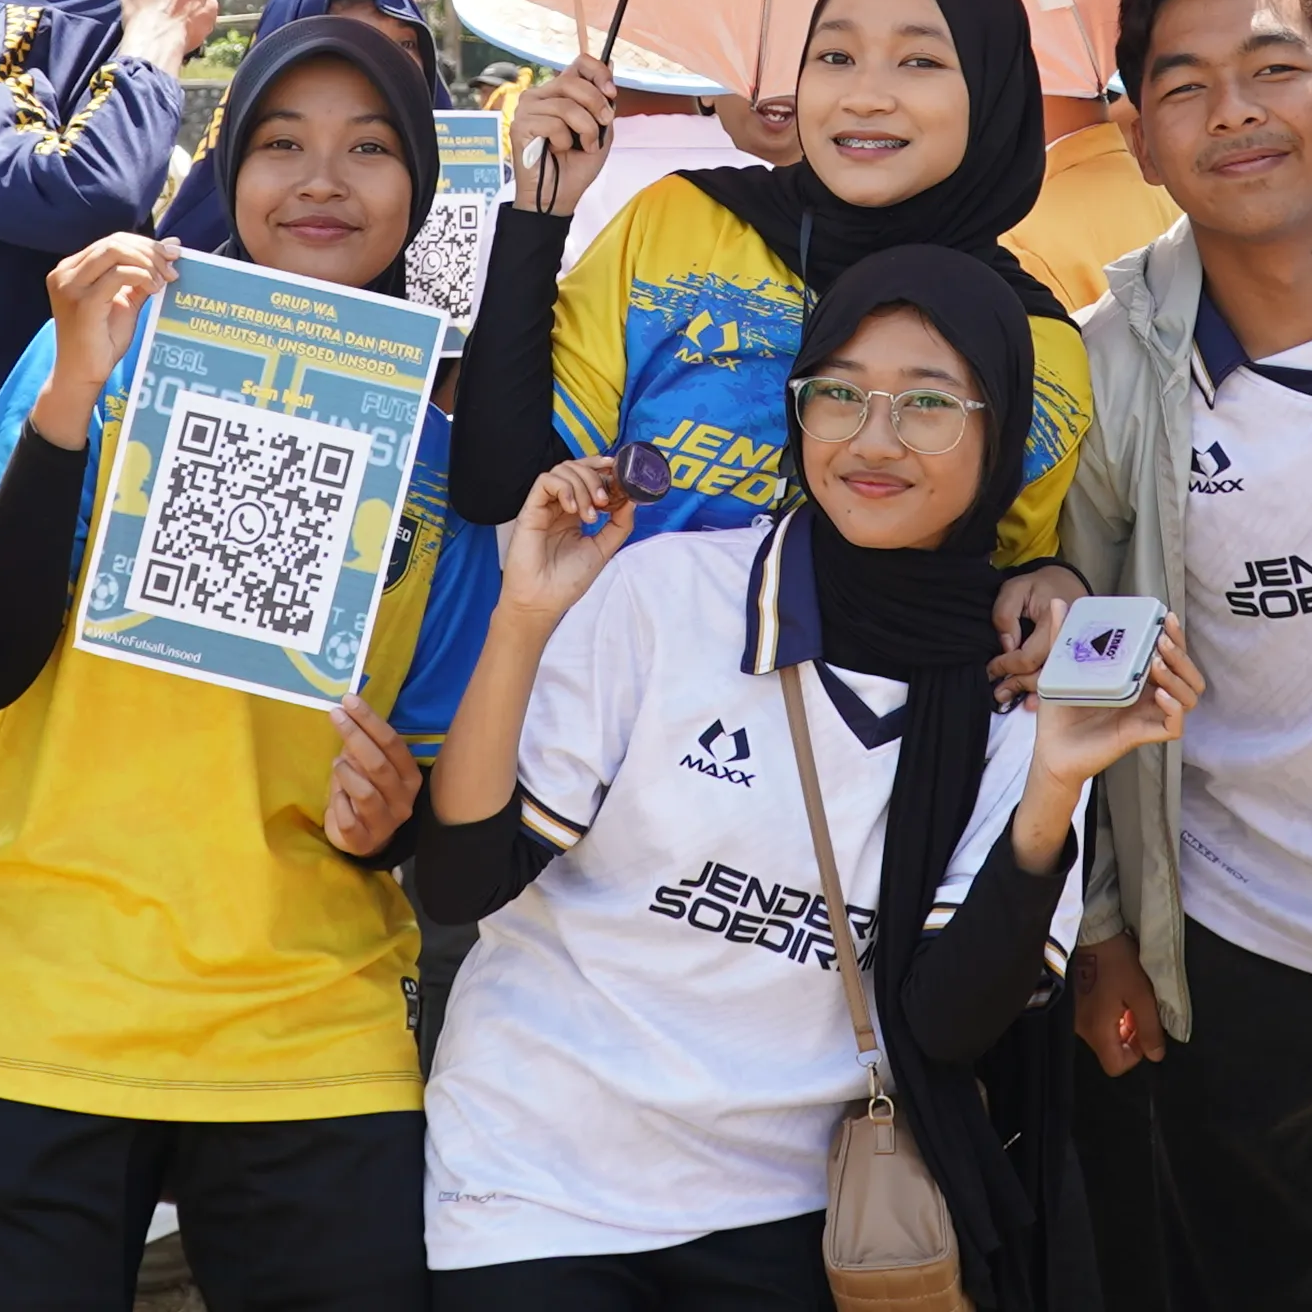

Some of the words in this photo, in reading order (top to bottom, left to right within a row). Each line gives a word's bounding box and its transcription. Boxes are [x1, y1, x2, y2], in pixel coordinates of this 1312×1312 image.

[174, 291, 227, 317] LATIAN
[230, 303, 294, 333] TERBUKA
[295, 319, 342, 344] PUTRA
[345, 331, 378, 351] DAN
[378, 339, 423, 364] PUTRI
[270, 291, 312, 315] GRUP
[312, 300, 337, 320] WA
[153, 341, 208, 376] TSAL
[189, 316, 221, 335] UKM
[222, 326, 275, 348] FUTSAL
[277, 338, 335, 363] UNSOED
[338, 353, 396, 377] UNSOED
[652, 419, 784, 474] JEN
[679, 754, 756, 788] MAXX
[648, 885, 877, 973] SOEDIR
[679, 860, 878, 940] JENDER
